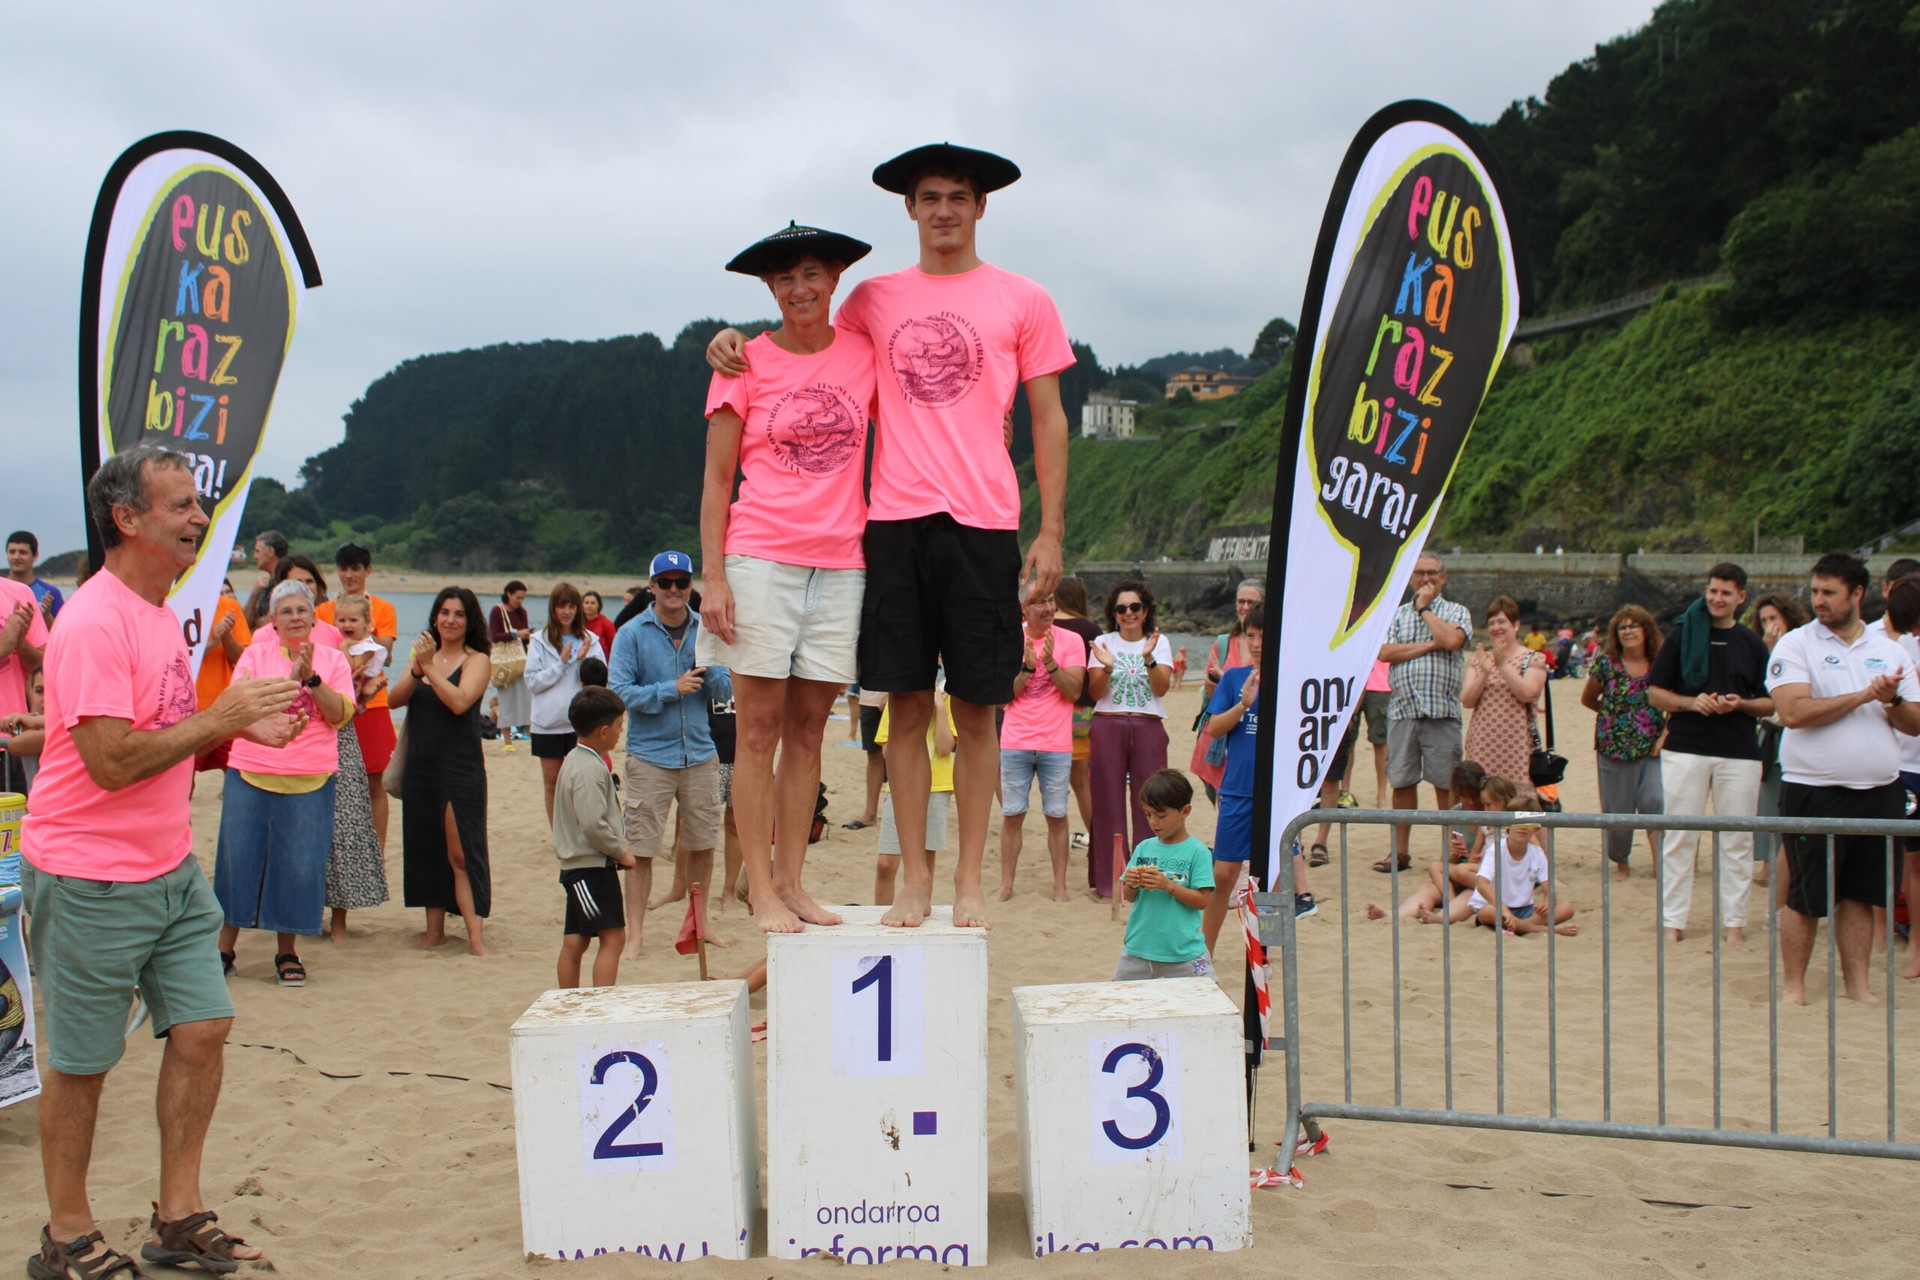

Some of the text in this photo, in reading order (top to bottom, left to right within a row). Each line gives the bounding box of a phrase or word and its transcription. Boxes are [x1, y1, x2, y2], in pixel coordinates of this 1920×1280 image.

[172, 194, 252, 265] eus
[1408, 176, 1481, 269] eus
[176, 260, 232, 323] ka
[1395, 252, 1454, 333] ka
[154, 318, 243, 386] raz
[1364, 313, 1454, 407] raz
[145, 378, 229, 445] bizi
[1348, 381, 1428, 475] bizi
[1322, 455, 1418, 539] gara!
[1297, 753, 1326, 789] o
[1298, 715, 1341, 752] ar
[851, 955, 892, 1062] 1
[590, 1050, 664, 1160] 2
[1101, 1042, 1171, 1150] 3
[816, 1199, 940, 1225] ondarroa
